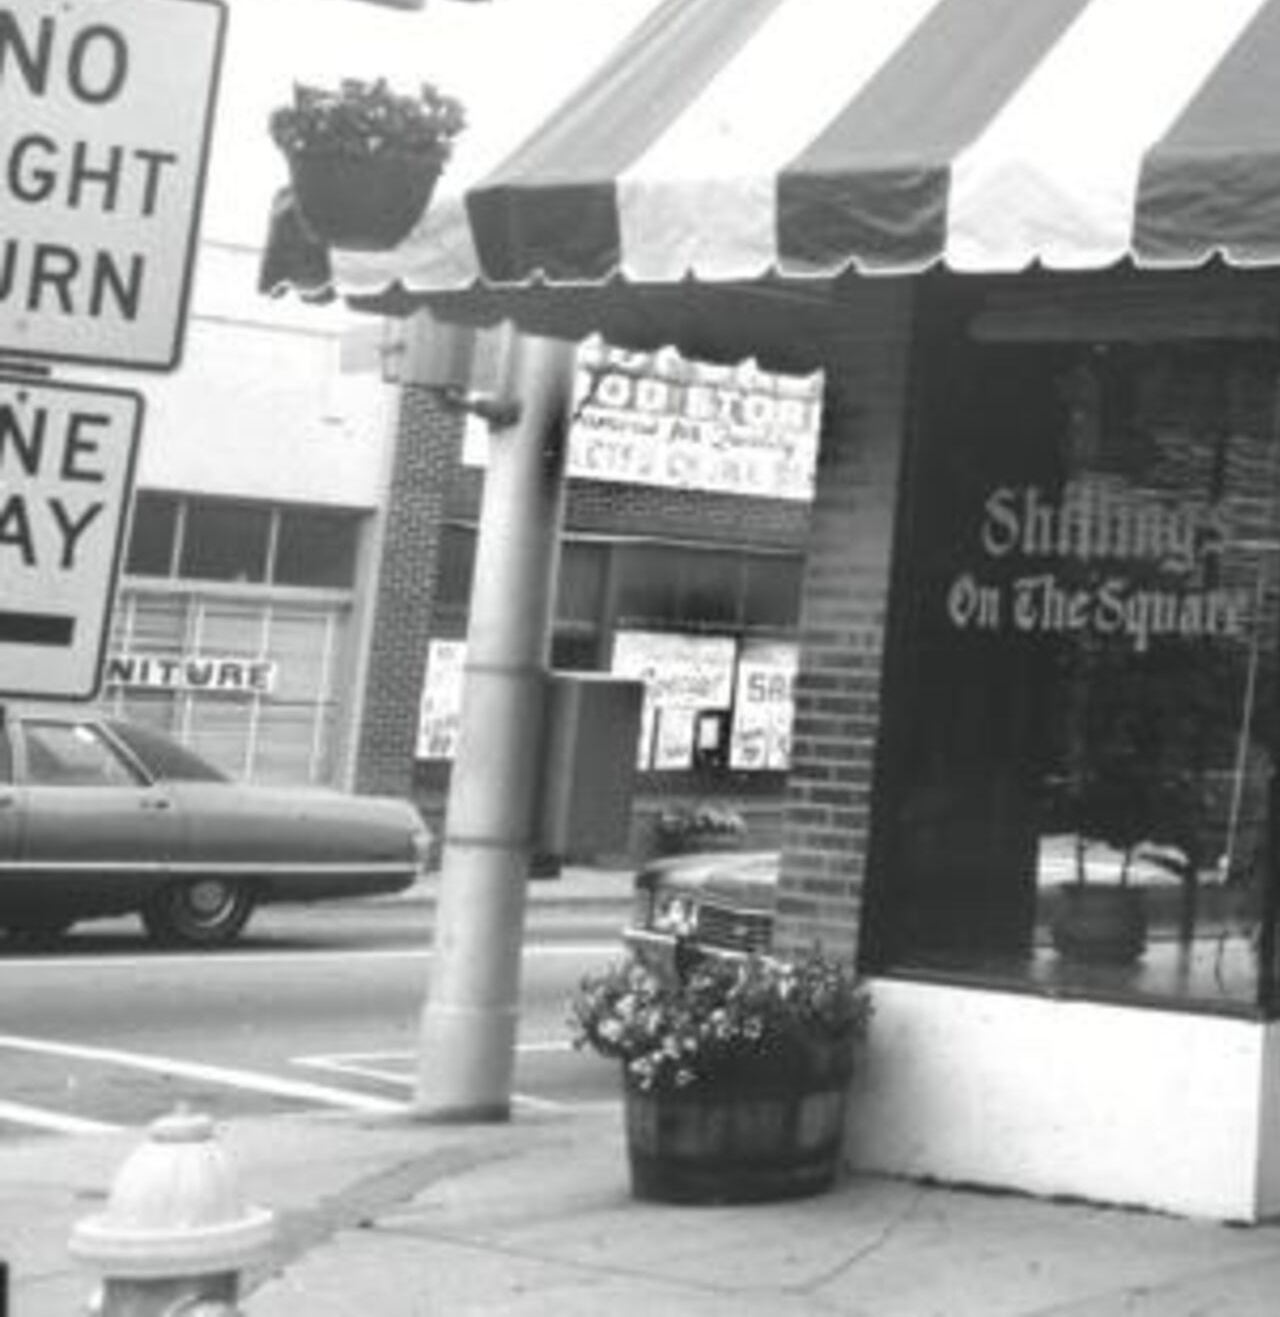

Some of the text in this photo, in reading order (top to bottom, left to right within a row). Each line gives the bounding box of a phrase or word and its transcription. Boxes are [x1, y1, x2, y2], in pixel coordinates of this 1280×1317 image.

[0, 8, 130, 106] NO
[980, 484, 1234, 576] Shillings
[948, 574, 1250, 654] On The Square
